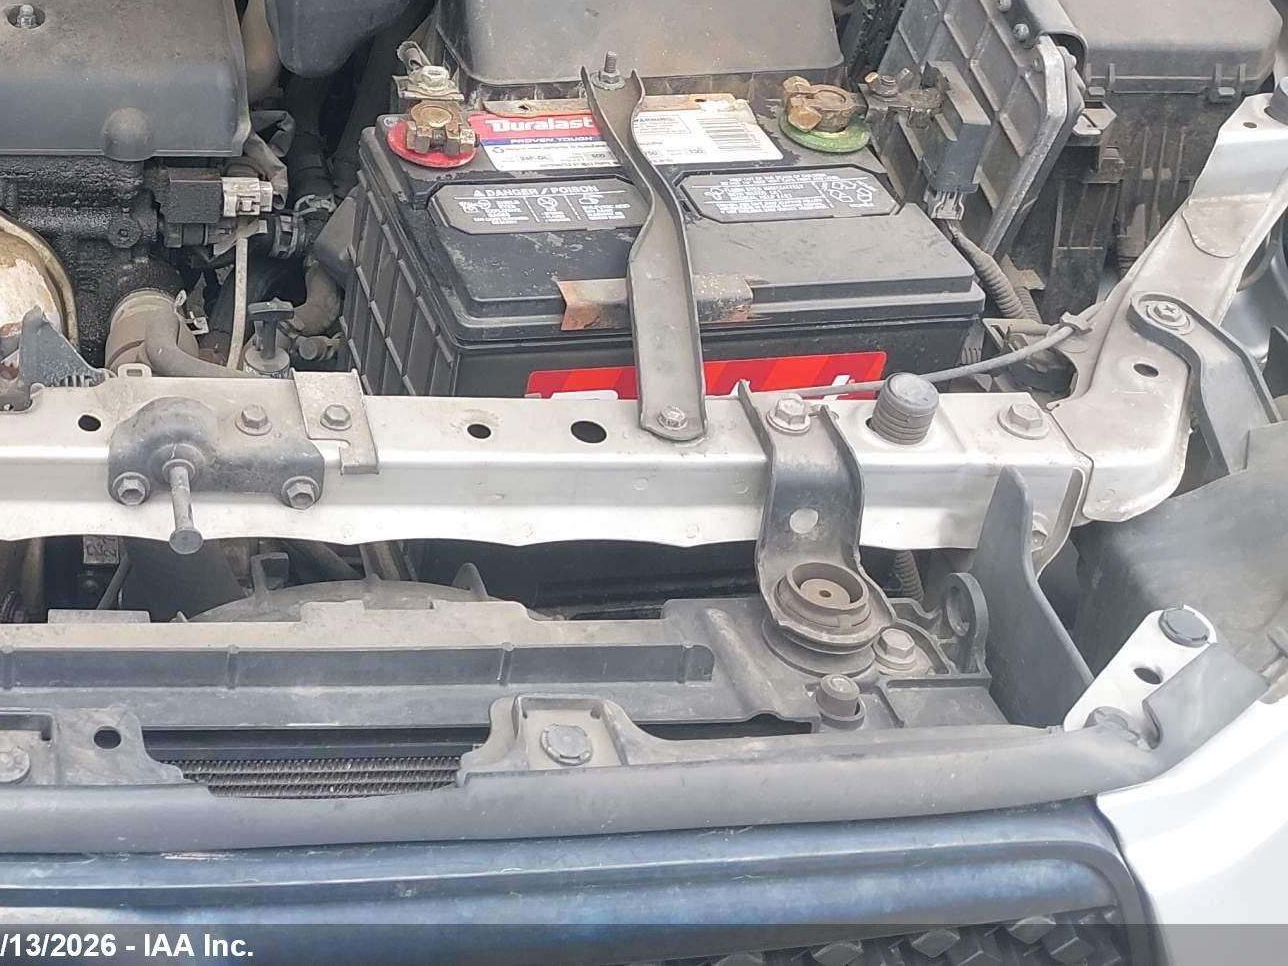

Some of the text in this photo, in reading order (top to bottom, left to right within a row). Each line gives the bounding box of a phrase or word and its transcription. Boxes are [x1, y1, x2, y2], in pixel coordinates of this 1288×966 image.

[485, 117, 595, 133] Duralast
[510, 137, 554, 145] PROVEN
[485, 187, 538, 197] DANGER
[550, 185, 600, 194] POISON
